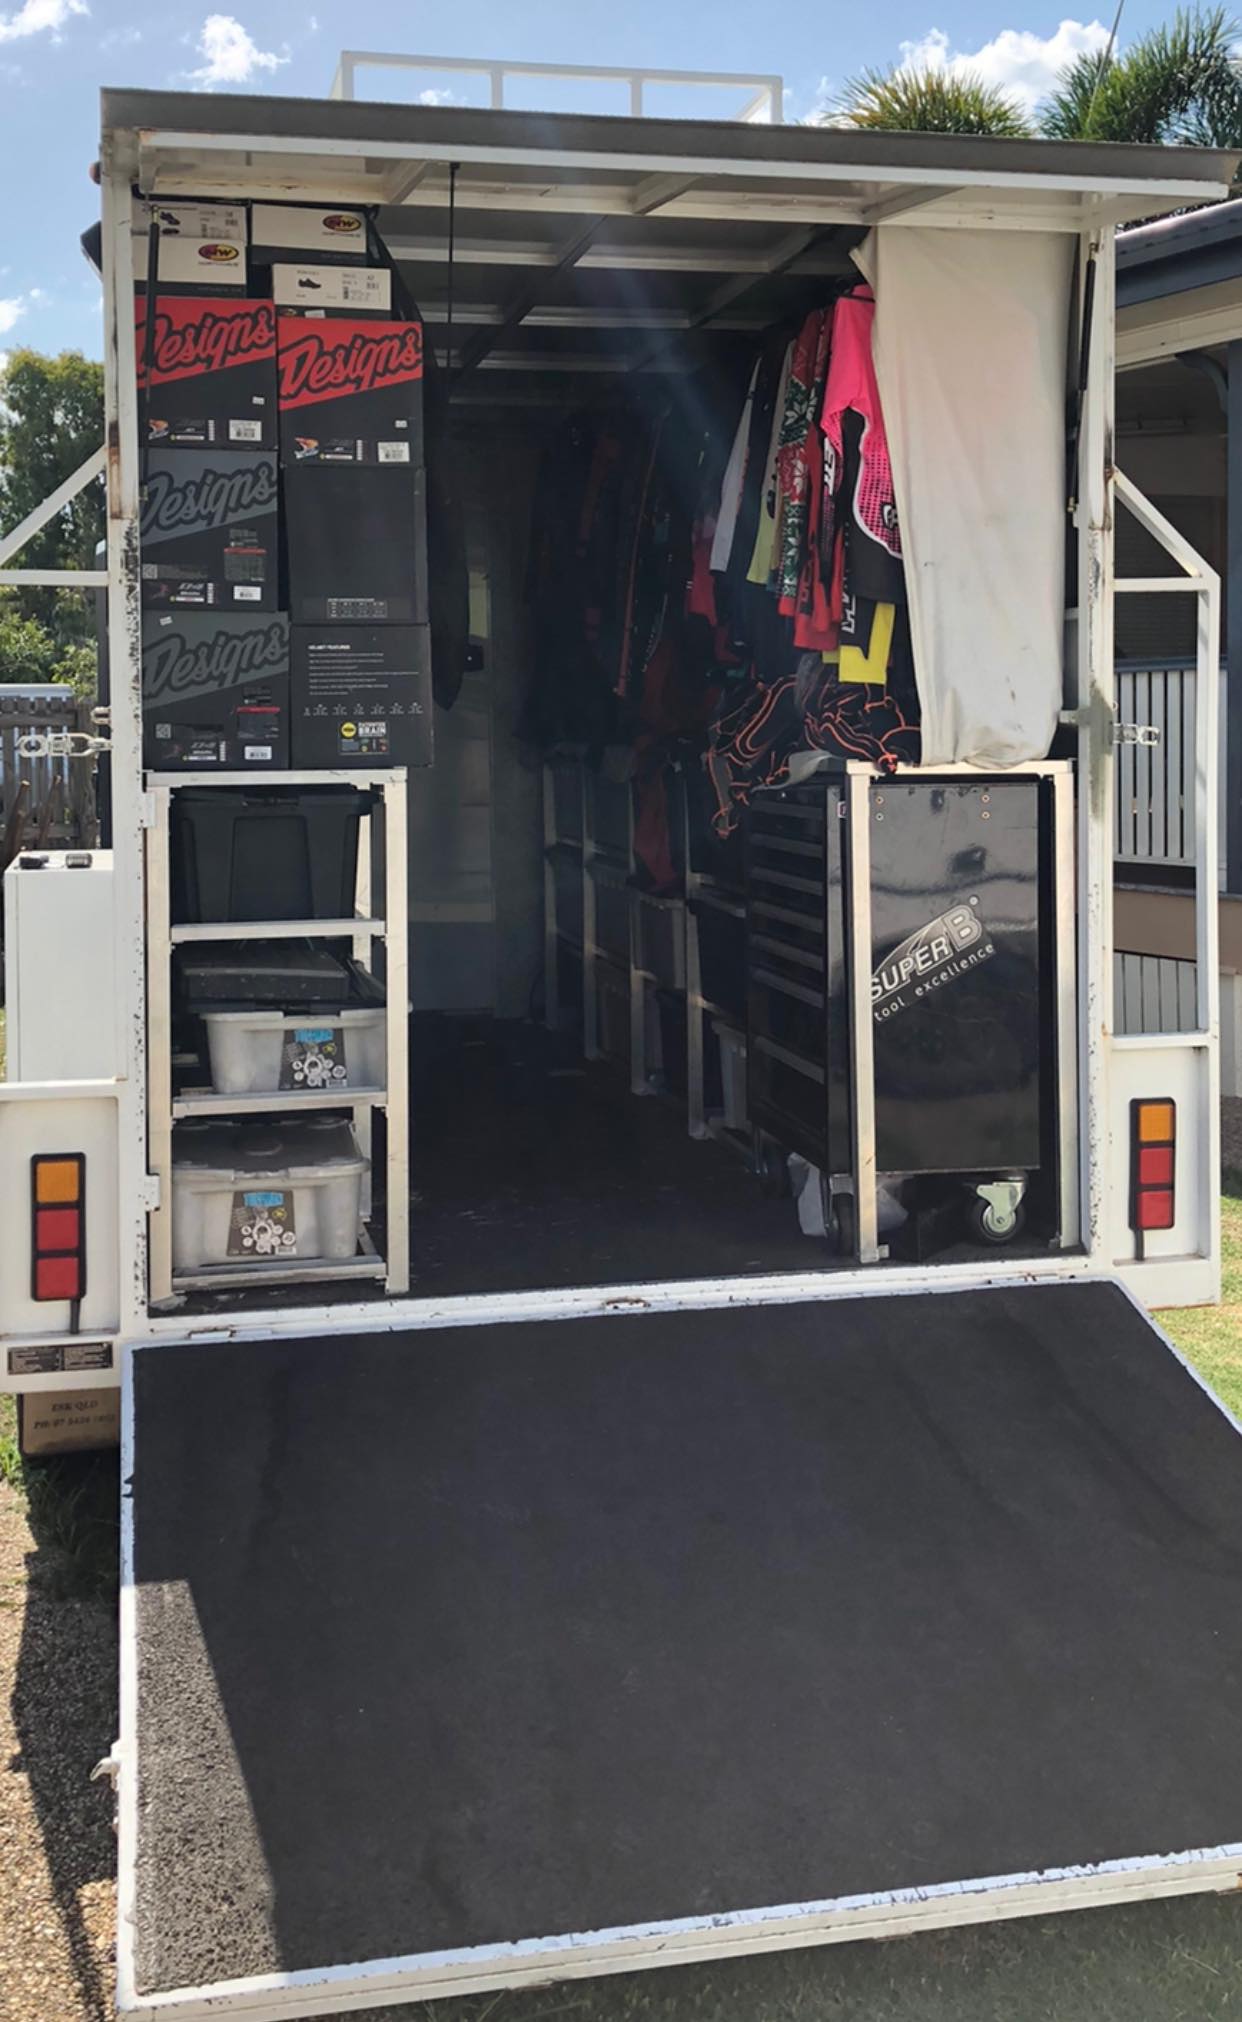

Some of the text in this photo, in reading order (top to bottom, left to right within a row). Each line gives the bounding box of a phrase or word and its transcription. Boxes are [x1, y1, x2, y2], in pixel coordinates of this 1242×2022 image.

[278, 330, 422, 398] Designs
[142, 625, 288, 696] Designs
[874, 943, 994, 1021] tool excellence
[74, 1400, 98, 1411] QLD
